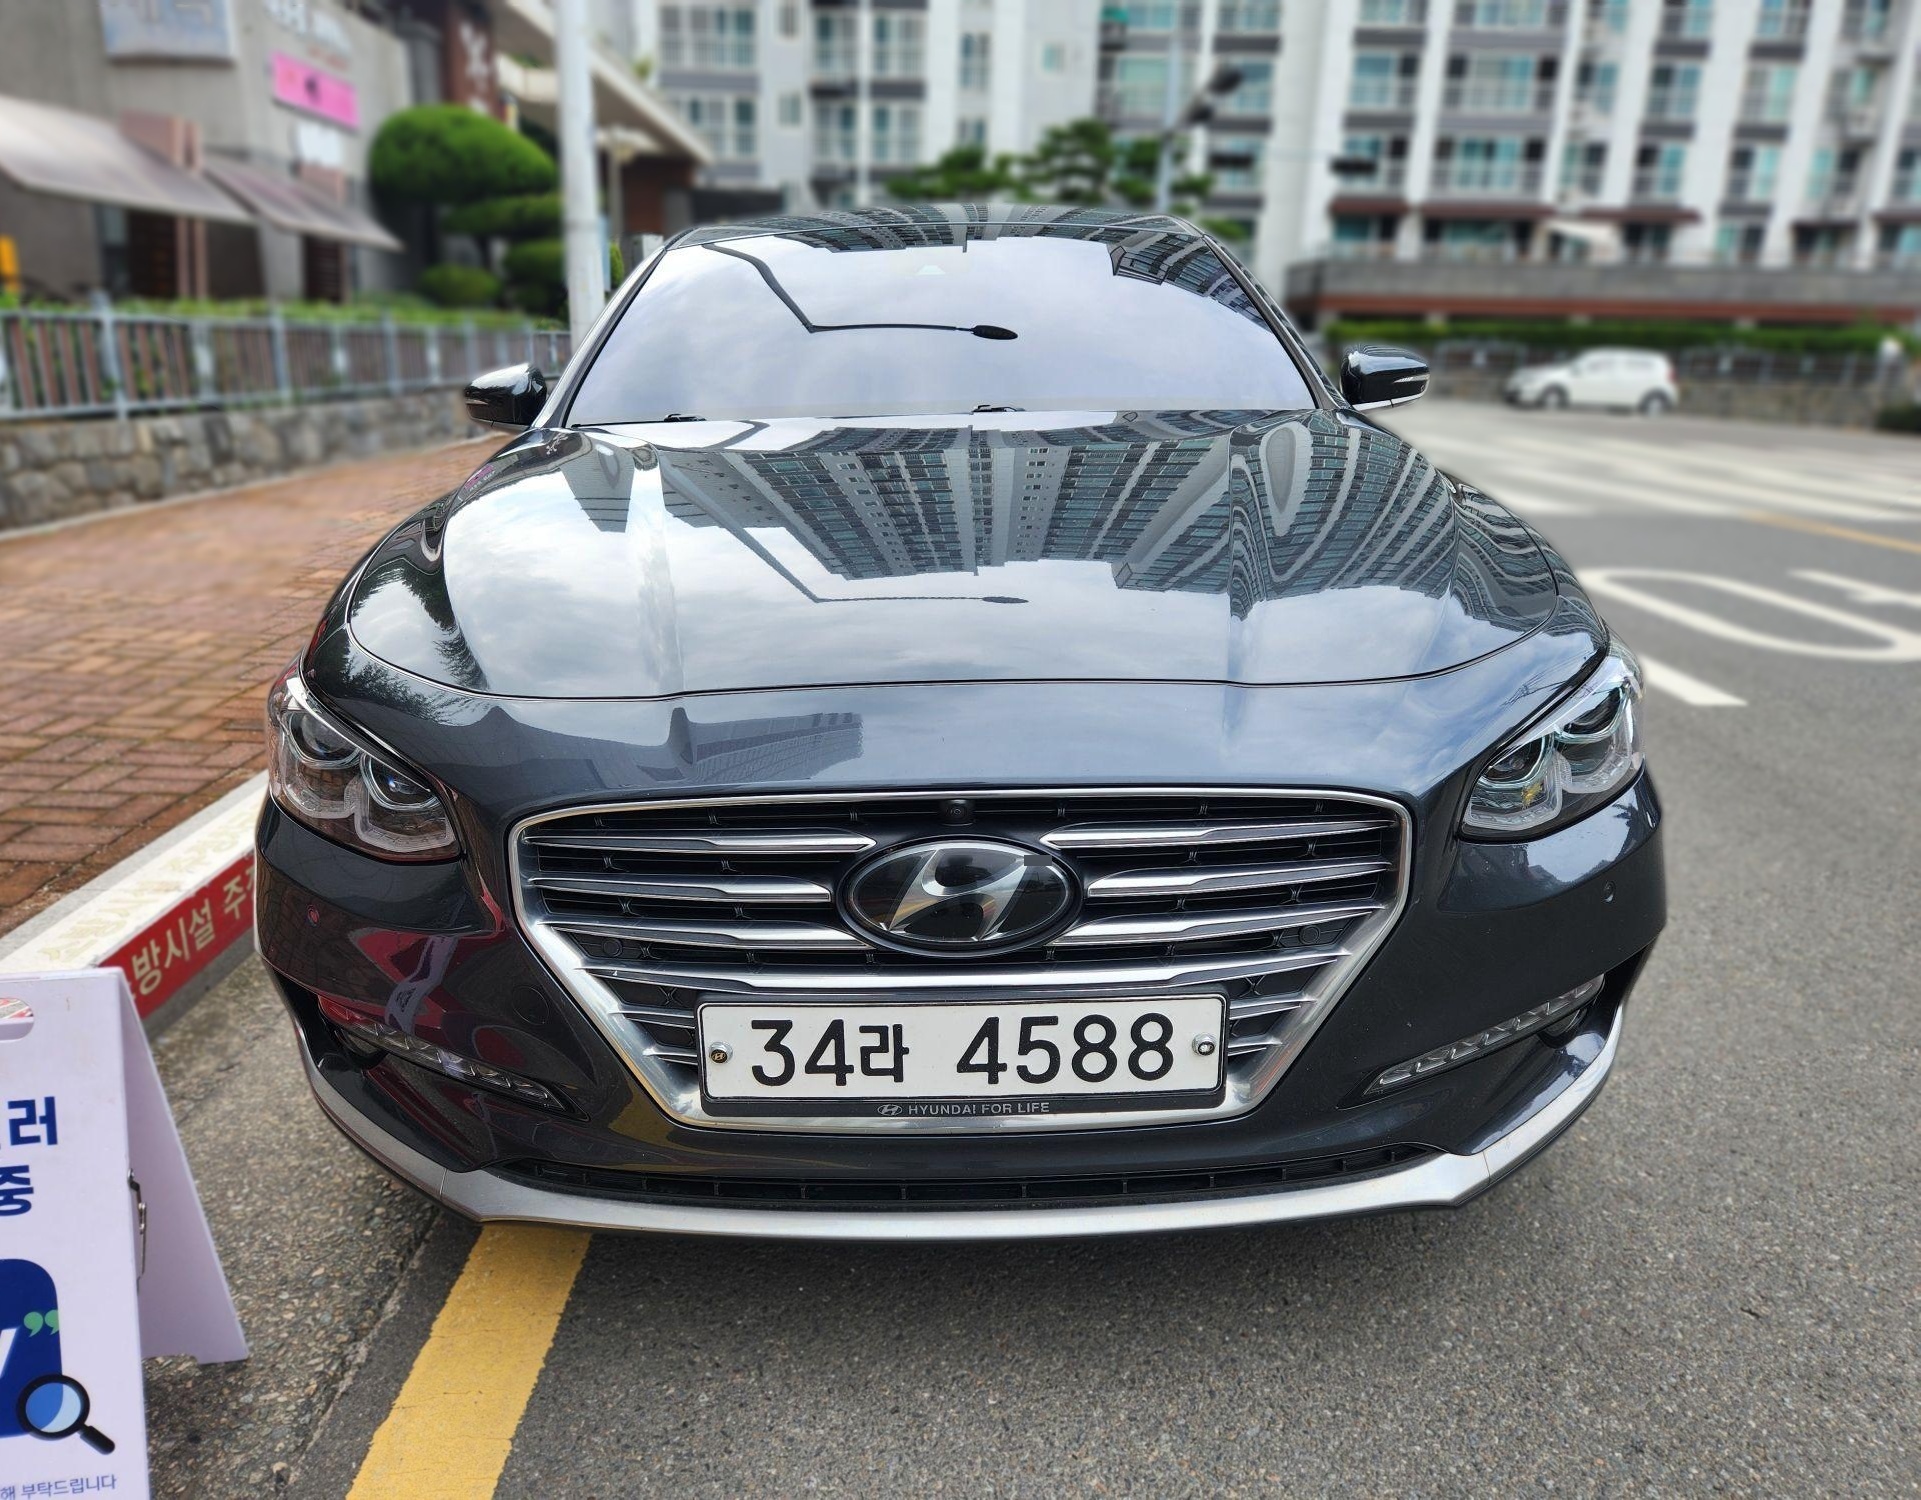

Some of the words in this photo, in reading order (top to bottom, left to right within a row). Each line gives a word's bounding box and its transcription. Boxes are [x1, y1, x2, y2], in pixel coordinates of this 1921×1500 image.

[129, 898, 216, 997] 방시설
[751, 1018, 910, 1087] 34라
[956, 1012, 1174, 1085] 4588
[908, 1104, 976, 1116] HYUNDAI
[981, 1103, 1012, 1114] FOR
[1017, 1102, 1050, 1113] LIFE
[21, 1474, 117, 1500] 부탁드립니다
